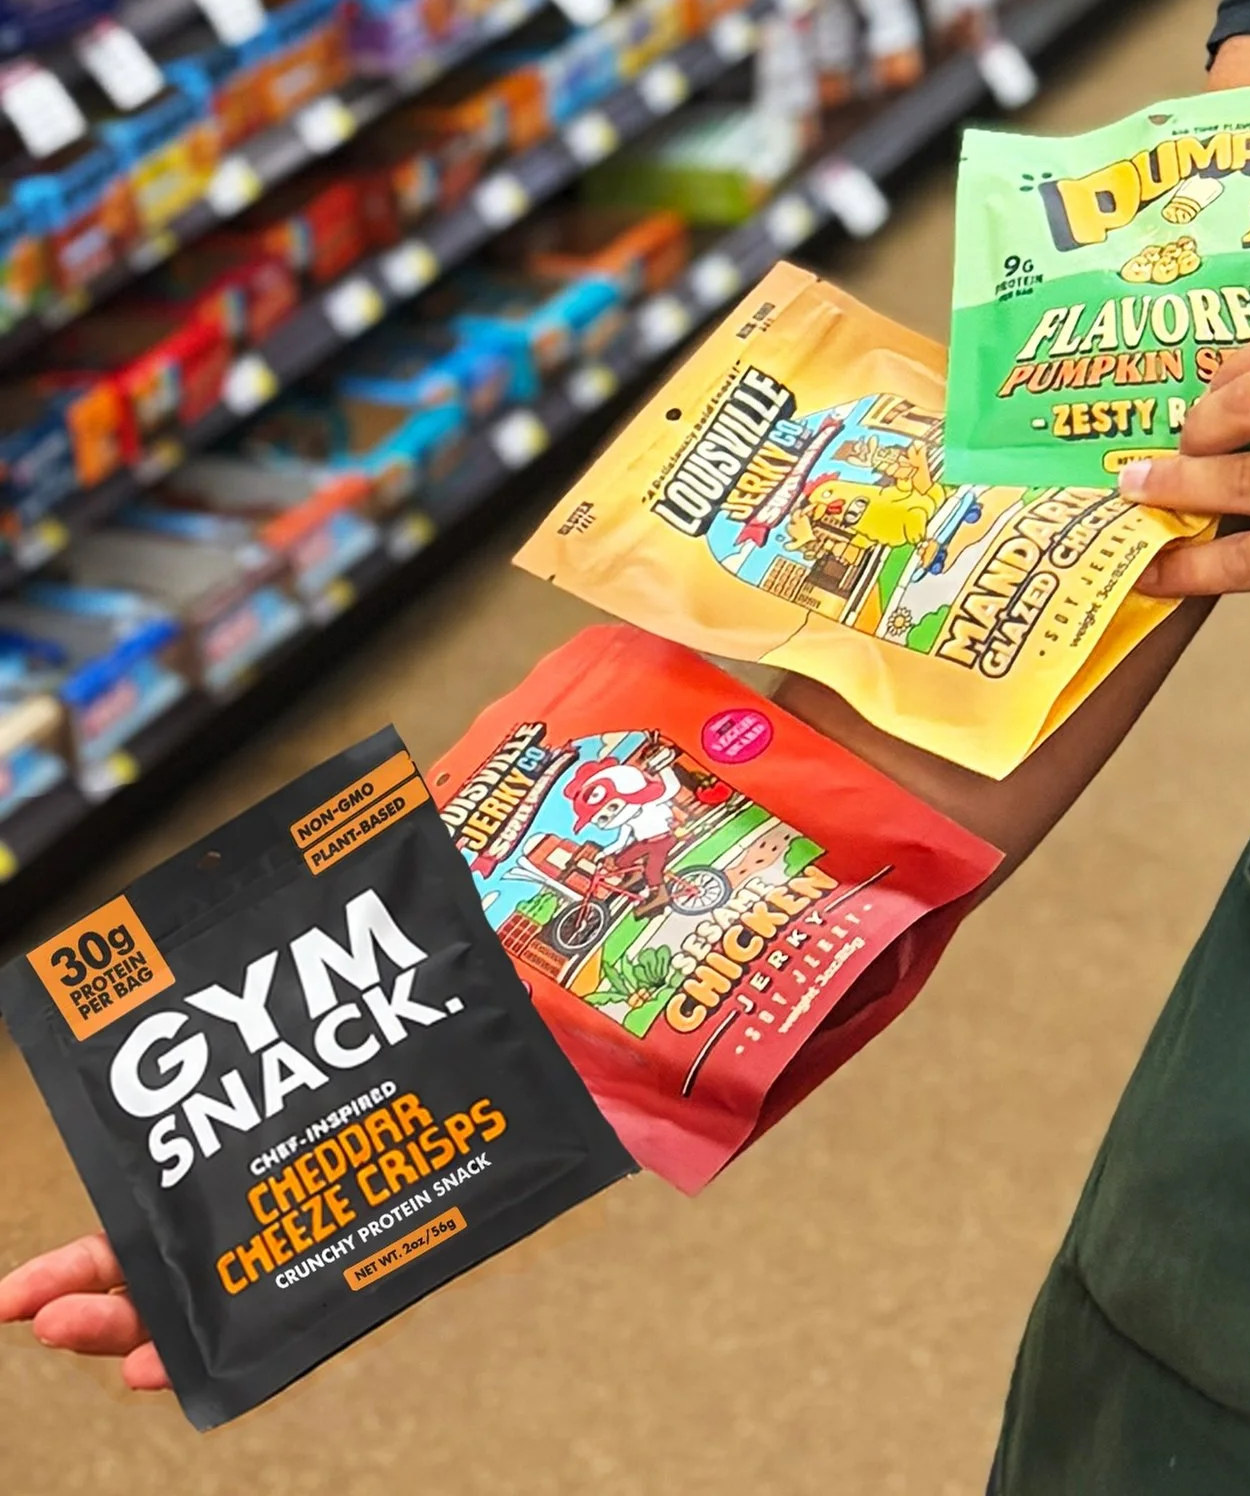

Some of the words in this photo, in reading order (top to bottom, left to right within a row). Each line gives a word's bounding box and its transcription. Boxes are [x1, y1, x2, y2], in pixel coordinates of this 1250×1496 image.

[999, 347, 1183, 397] PUMPKIN
[651, 367, 791, 536] LOUISVILLE
[721, 440, 799, 520] JERKY
[1044, 596, 1078, 641] SOY
[296, 782, 375, 841] NON-GMO
[440, 722, 544, 837] UISVILLE
[462, 767, 535, 851] JERKY
[311, 797, 407, 868] PLANT-BASED
[50, 923, 136, 988] 30g
[69, 950, 148, 1007] PROTEIN
[666, 864, 839, 1032] CHICKEN
[737, 910, 824, 1013] JERKY
[78, 990, 113, 1021] PER
[115, 967, 154, 1001] BAG
[110, 888, 428, 1118] GYM
[148, 967, 465, 1188] SNACK.
[247, 1092, 434, 1226] CHEDDAR
[250, 1080, 397, 1176] CHEF-INSPIRED
[215, 1183, 357, 1296] CHEEZE
[355, 1097, 508, 1207] CRISPS
[275, 1233, 356, 1290] CRUNCHY
[357, 1189, 433, 1243] PROTEIN
[433, 1152, 492, 1197] SNACK
[354, 1263, 378, 1282] NET
[378, 1251, 403, 1269] WT.
[402, 1217, 457, 1254] 2oz/56g
